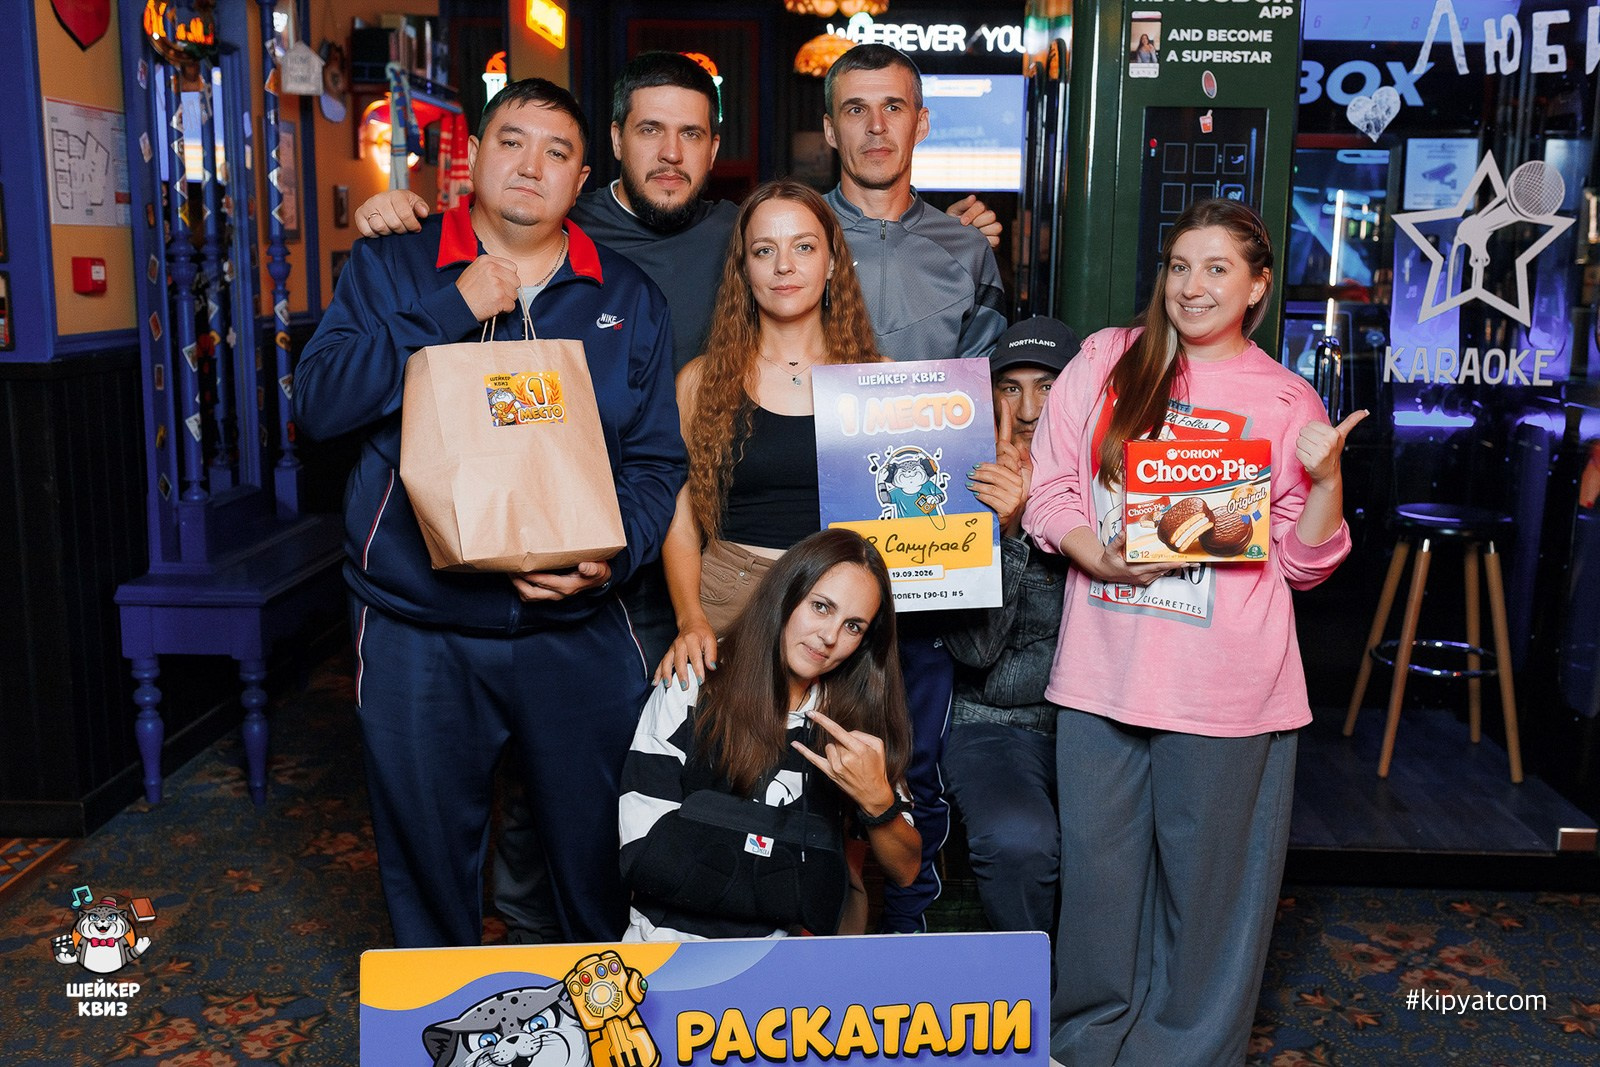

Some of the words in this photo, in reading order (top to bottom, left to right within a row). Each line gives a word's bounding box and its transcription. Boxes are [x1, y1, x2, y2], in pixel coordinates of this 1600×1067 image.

[1259, 6, 1294, 19] APP
[1313, 15, 1322, 29] 6
[1411, 16, 1420, 30] 8
[1168, 28, 1203, 42] AND
[1206, 29, 1273, 43] BECOME
[1166, 50, 1179, 63] A
[1181, 50, 1272, 64] SUPERSTAR
[600, 312, 618, 324] NIKE
[1008, 338, 1057, 348] NORTHLAND
[1383, 345, 1556, 387] KARAOKE
[857, 372, 908, 386] ШЕЙКЕР
[911, 371, 946, 384] КВИЗ
[519, 404, 564, 422] МЕСТО
[835, 393, 860, 436] 1
[864, 391, 975, 435] МЕСТО
[1180, 449, 1220, 459] ORION
[1226, 486, 1267, 514] Original
[1140, 550, 1150, 559] 12
[1142, 595, 1202, 615] CIGARETTES
[676, 999, 1032, 1064] РАСКАТАЛИ
